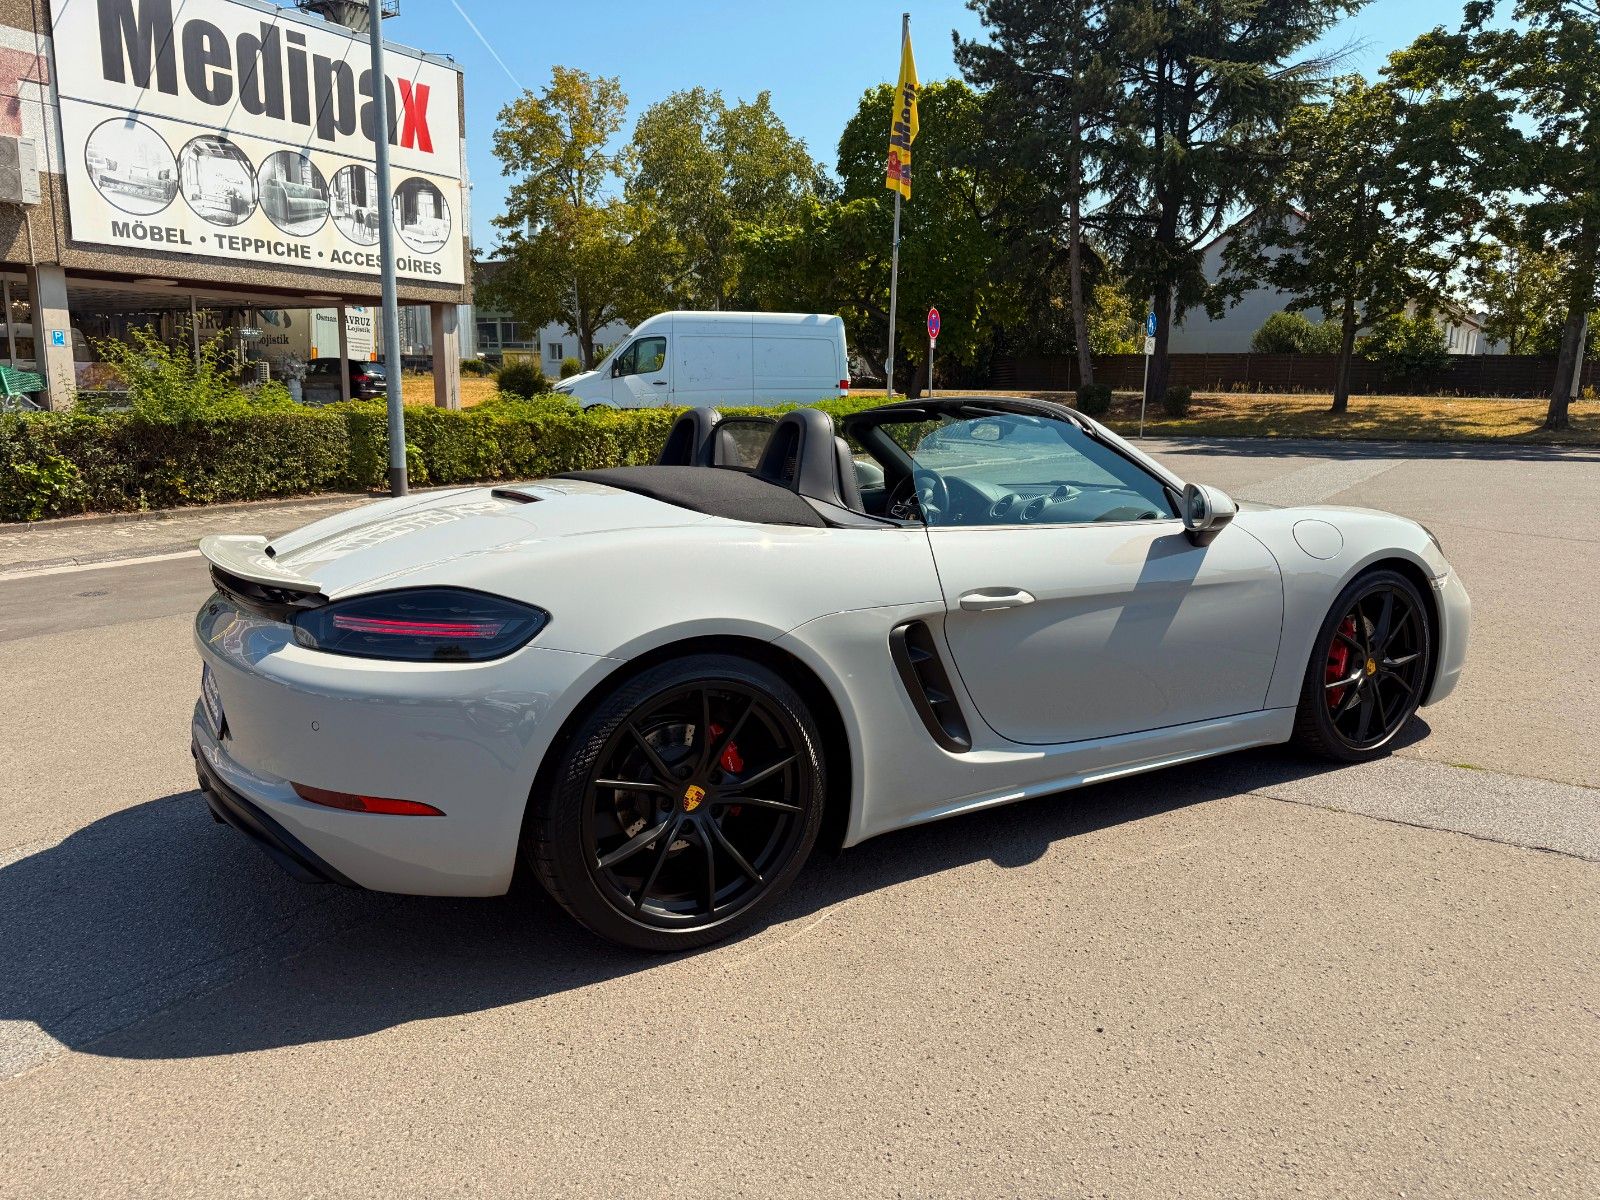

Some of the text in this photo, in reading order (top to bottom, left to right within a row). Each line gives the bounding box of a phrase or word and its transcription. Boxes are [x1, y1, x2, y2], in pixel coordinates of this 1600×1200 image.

[97, 0, 434, 154] Medipax
[111, 220, 192, 246] MÖBEL
[214, 233, 312, 260] TEPPICHE
